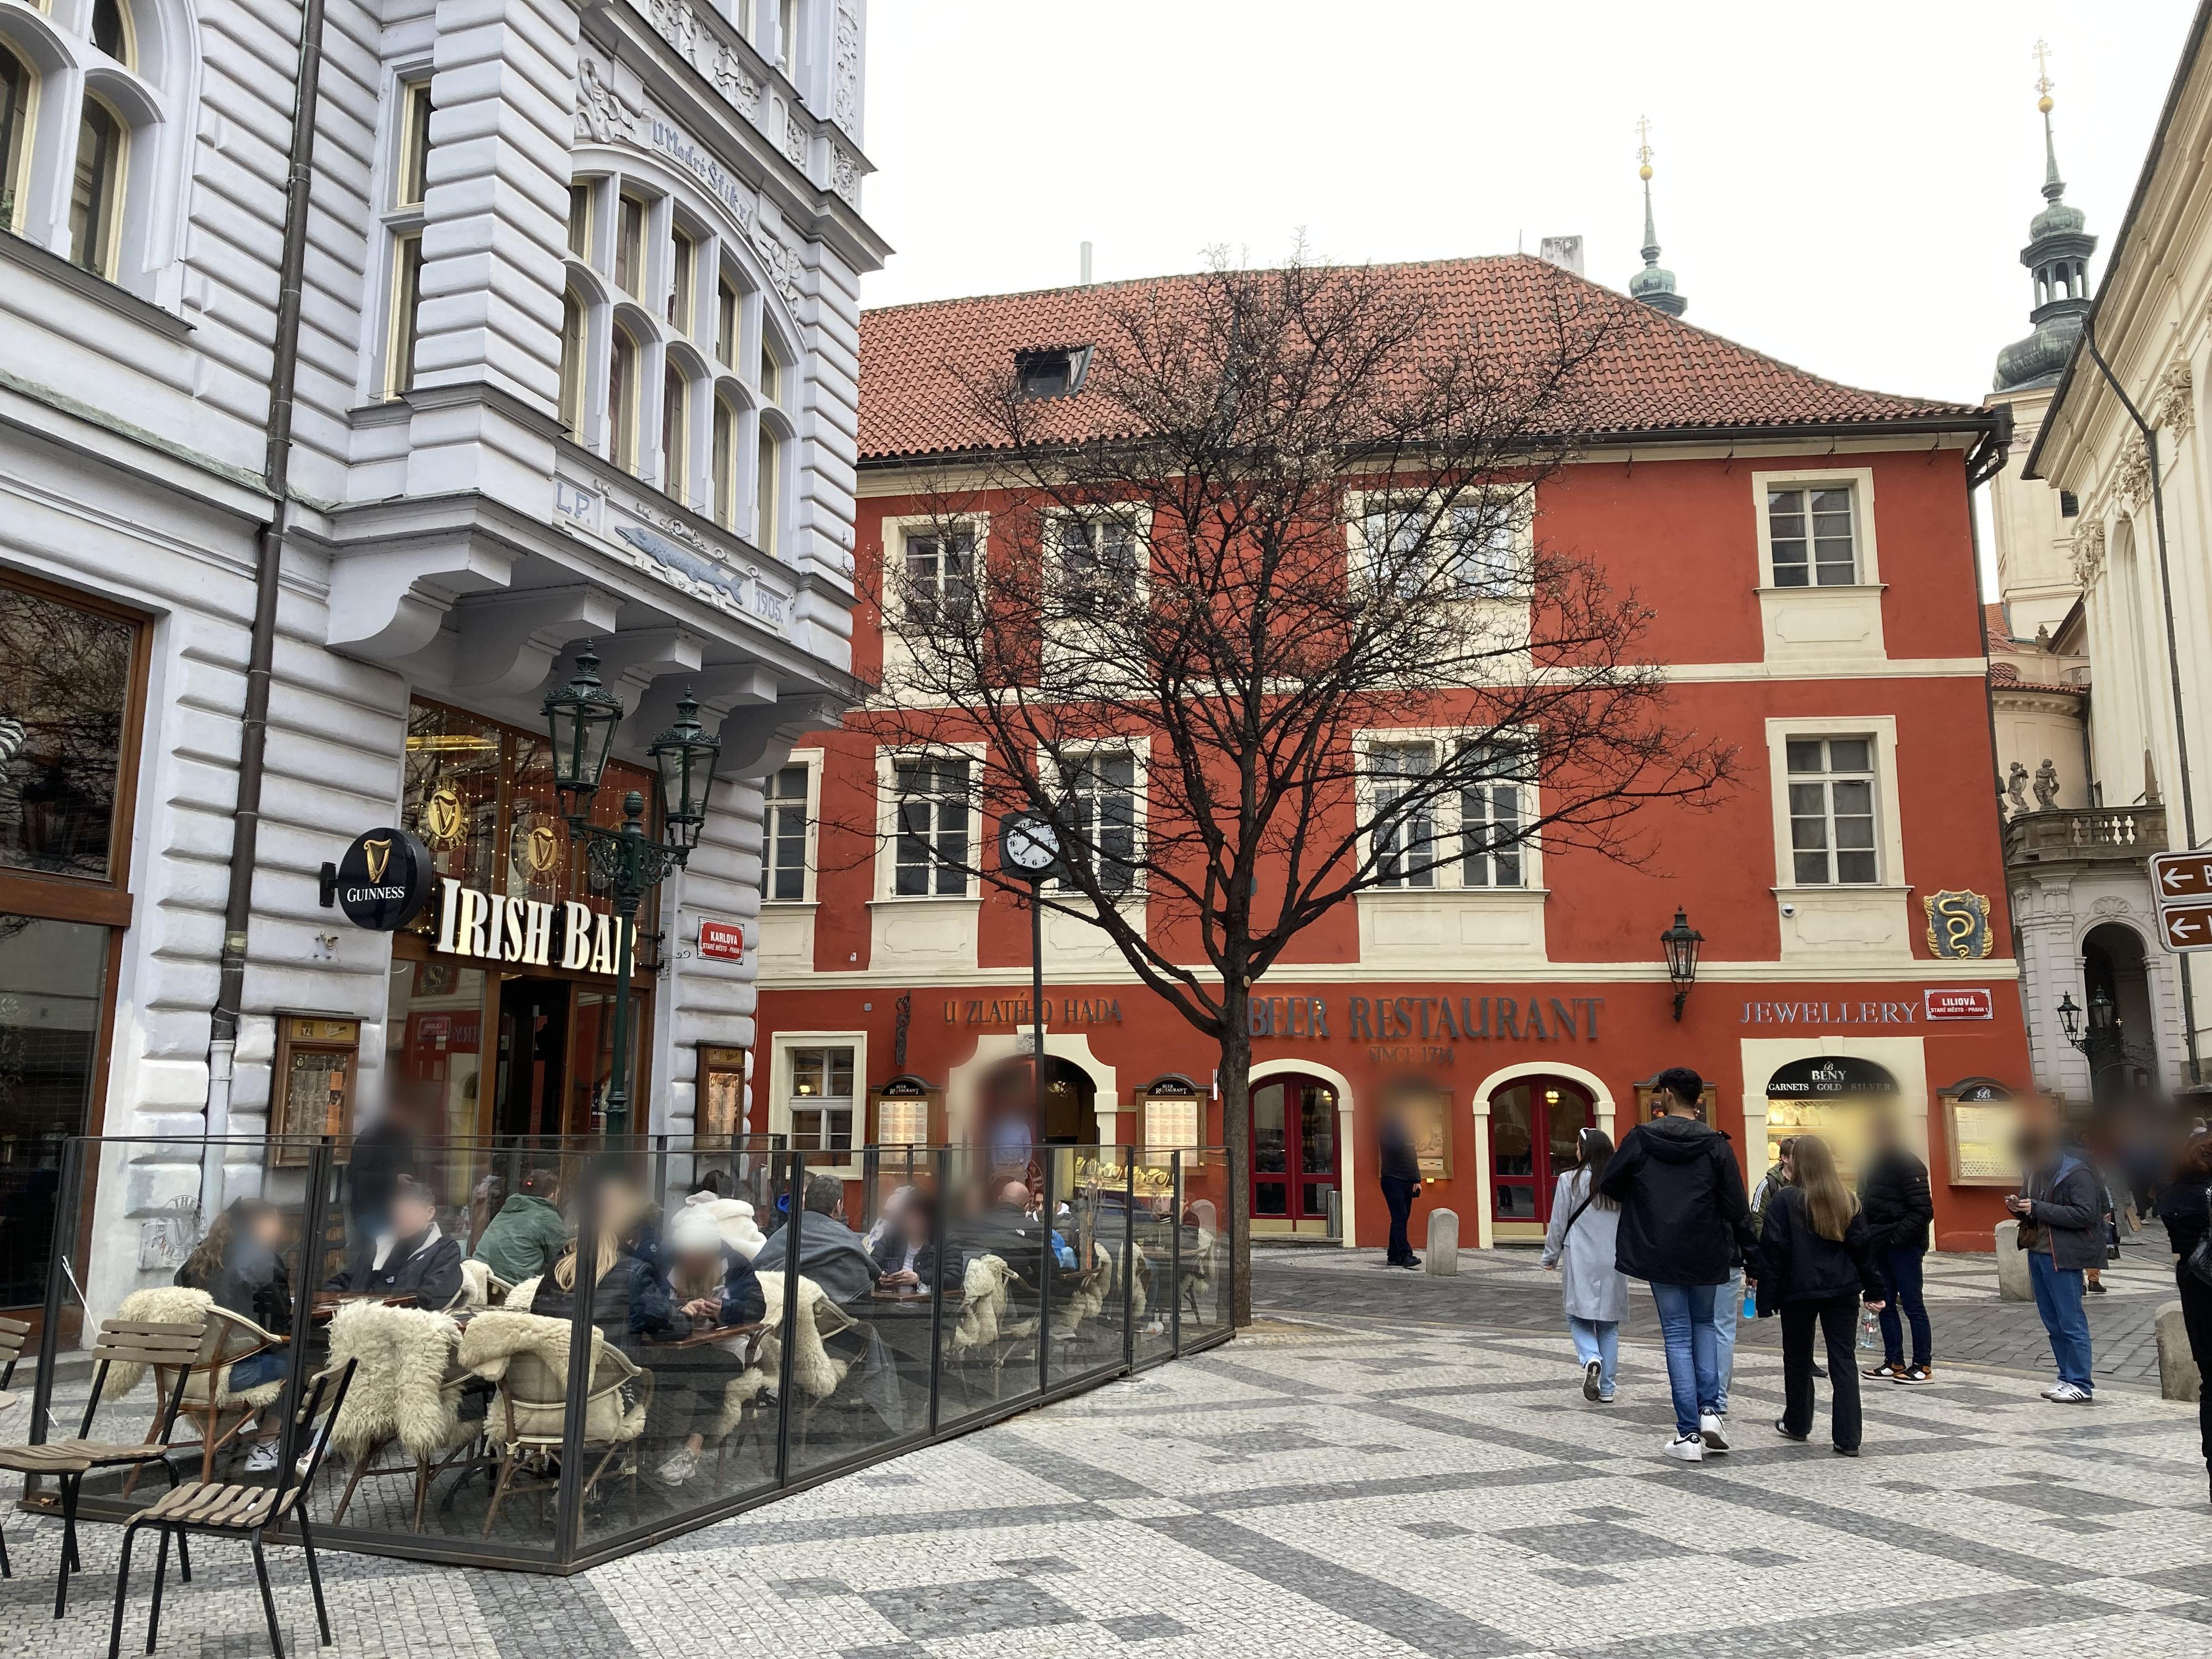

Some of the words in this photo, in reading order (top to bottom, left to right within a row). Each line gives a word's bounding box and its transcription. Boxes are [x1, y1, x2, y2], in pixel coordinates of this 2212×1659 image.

[653, 118, 664, 145] U
[347, 886, 405, 902] GUINNESS
[436, 877, 554, 966] IRISH
[561, 900, 637, 977] BAR
[710, 931, 738, 945] KARLOVA
[715, 943, 727, 952] MĚSTO
[943, 1001, 956, 1024] U
[966, 992, 1053, 1024] ZLATÉHO
[1063, 999, 1122, 1022] HADA
[1942, 996, 1976, 1006] LILIOVÁ
[1248, 997, 1330, 1037] BEER
[1348, 996, 1604, 1039] RESTAURANT
[1740, 1001, 1921, 1024] JEWELLERY
[1368, 1046, 1415, 1063] SINCE
[1812, 1070, 1846, 1080] BENY
[1768, 1083, 1809, 1091] GARNETS
[1817, 1083, 1842, 1091] GOLD
[1851, 1083, 1891, 1091] SILVER
